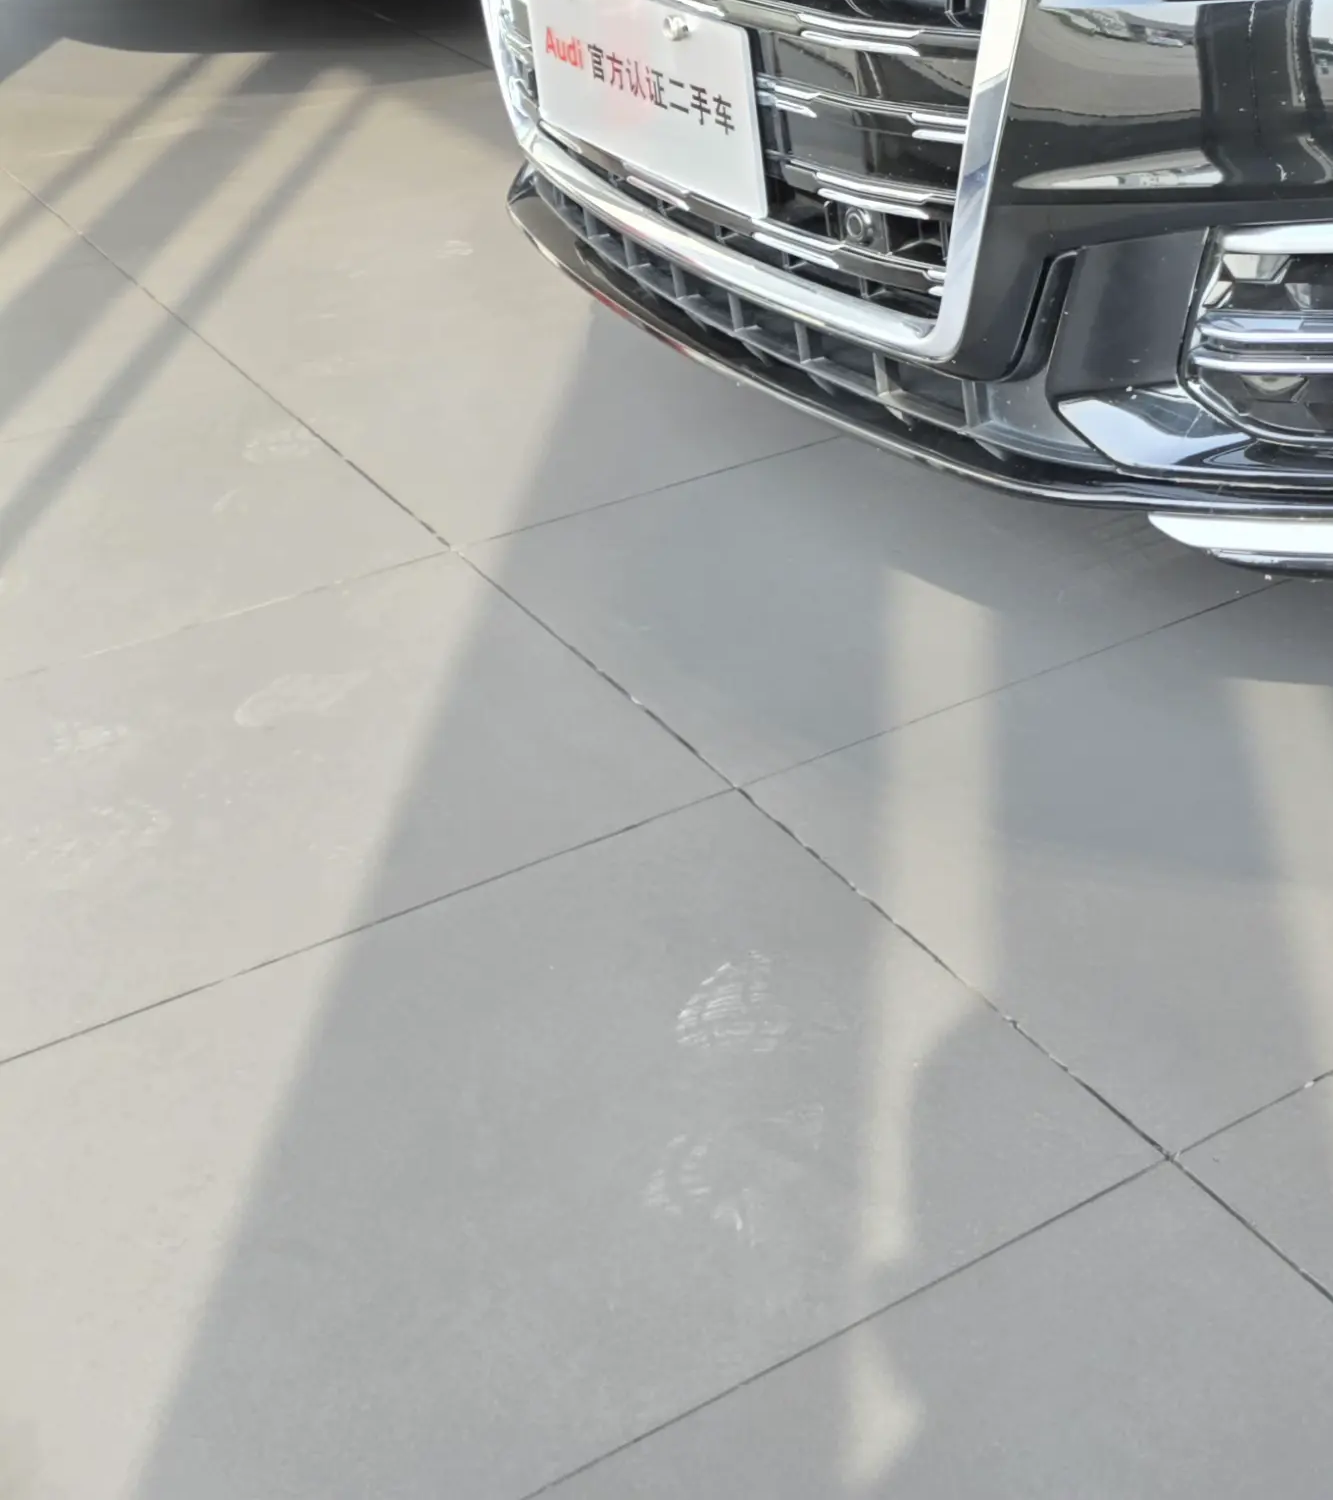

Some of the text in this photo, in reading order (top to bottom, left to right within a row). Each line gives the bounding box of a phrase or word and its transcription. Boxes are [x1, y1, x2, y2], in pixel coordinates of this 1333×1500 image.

[545, 26, 735, 136] Audi 官方认证二手车
